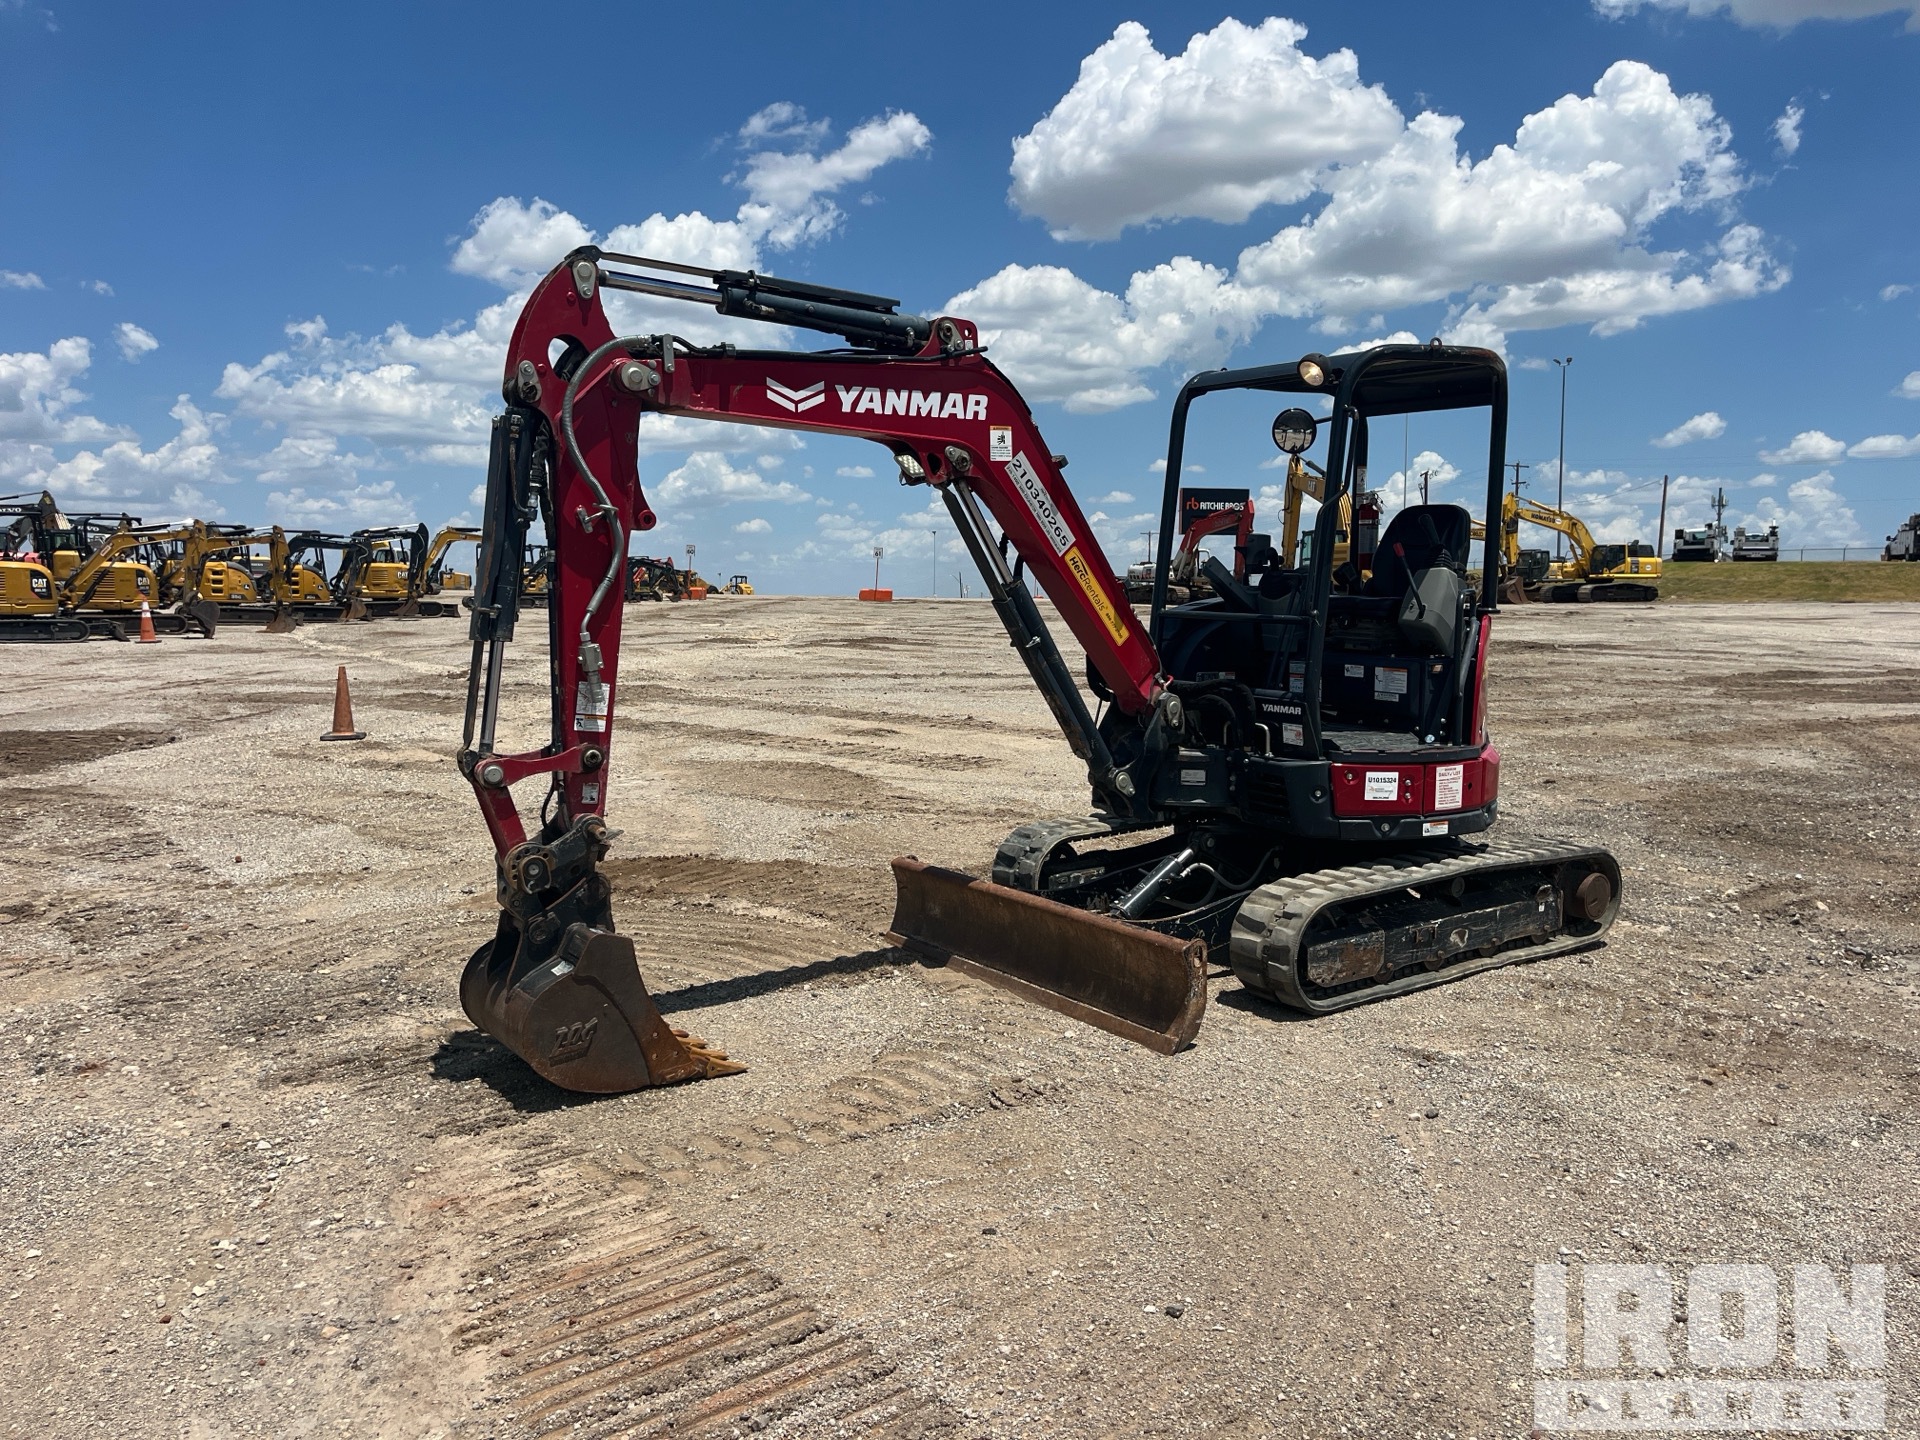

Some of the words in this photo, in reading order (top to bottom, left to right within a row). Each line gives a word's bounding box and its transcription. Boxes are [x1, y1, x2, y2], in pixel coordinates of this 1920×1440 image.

[834, 384, 989, 421] YANMAR
[1012, 458, 1069, 547] 210340265
[1186, 497, 1200, 510] rb
[1200, 501, 1225, 511] RITCHIE
[137, 577, 150, 585] CAT
[397, 571, 409, 579] CAT
[32, 578, 47, 588] CAT
[1262, 703, 1302, 715] YANMAR
